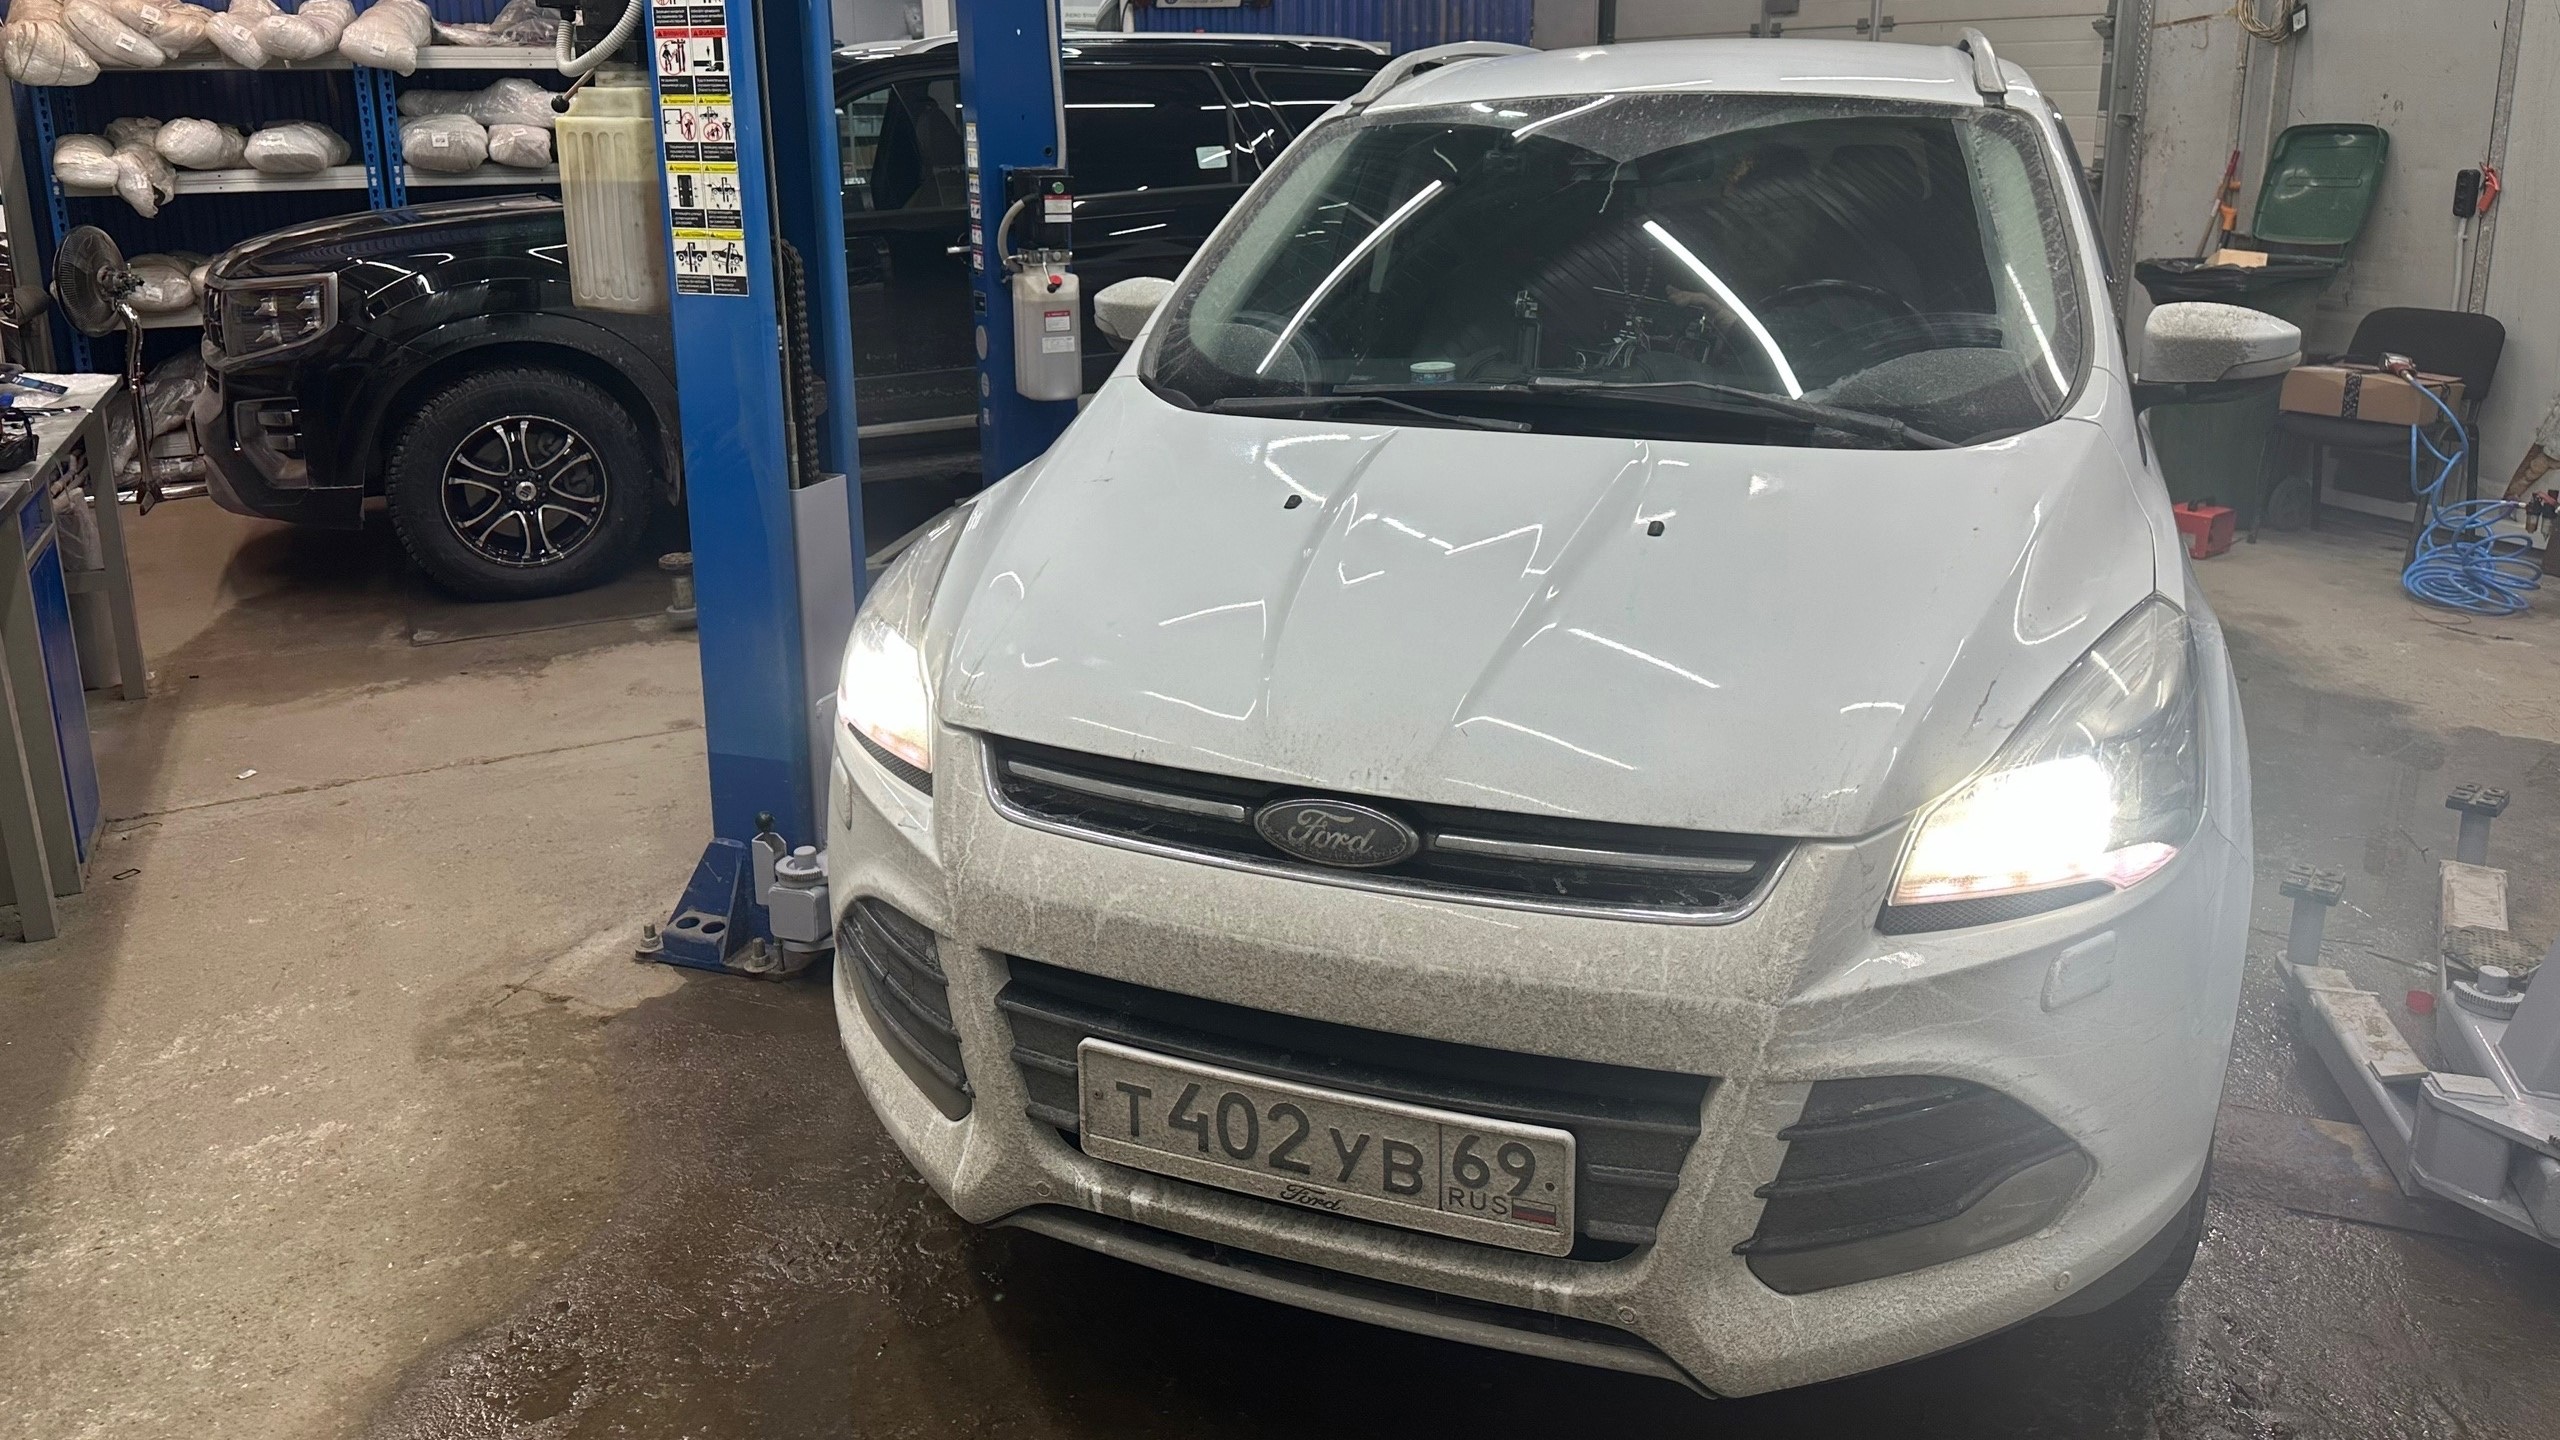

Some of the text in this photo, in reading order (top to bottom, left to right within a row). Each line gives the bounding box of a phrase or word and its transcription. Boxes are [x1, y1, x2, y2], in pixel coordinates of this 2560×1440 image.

[1288, 809, 1376, 854] Ford
[1452, 1134, 1536, 1197] 69
[1280, 1184, 1342, 1210] Ford
[1449, 1187, 1507, 1216] RUS
